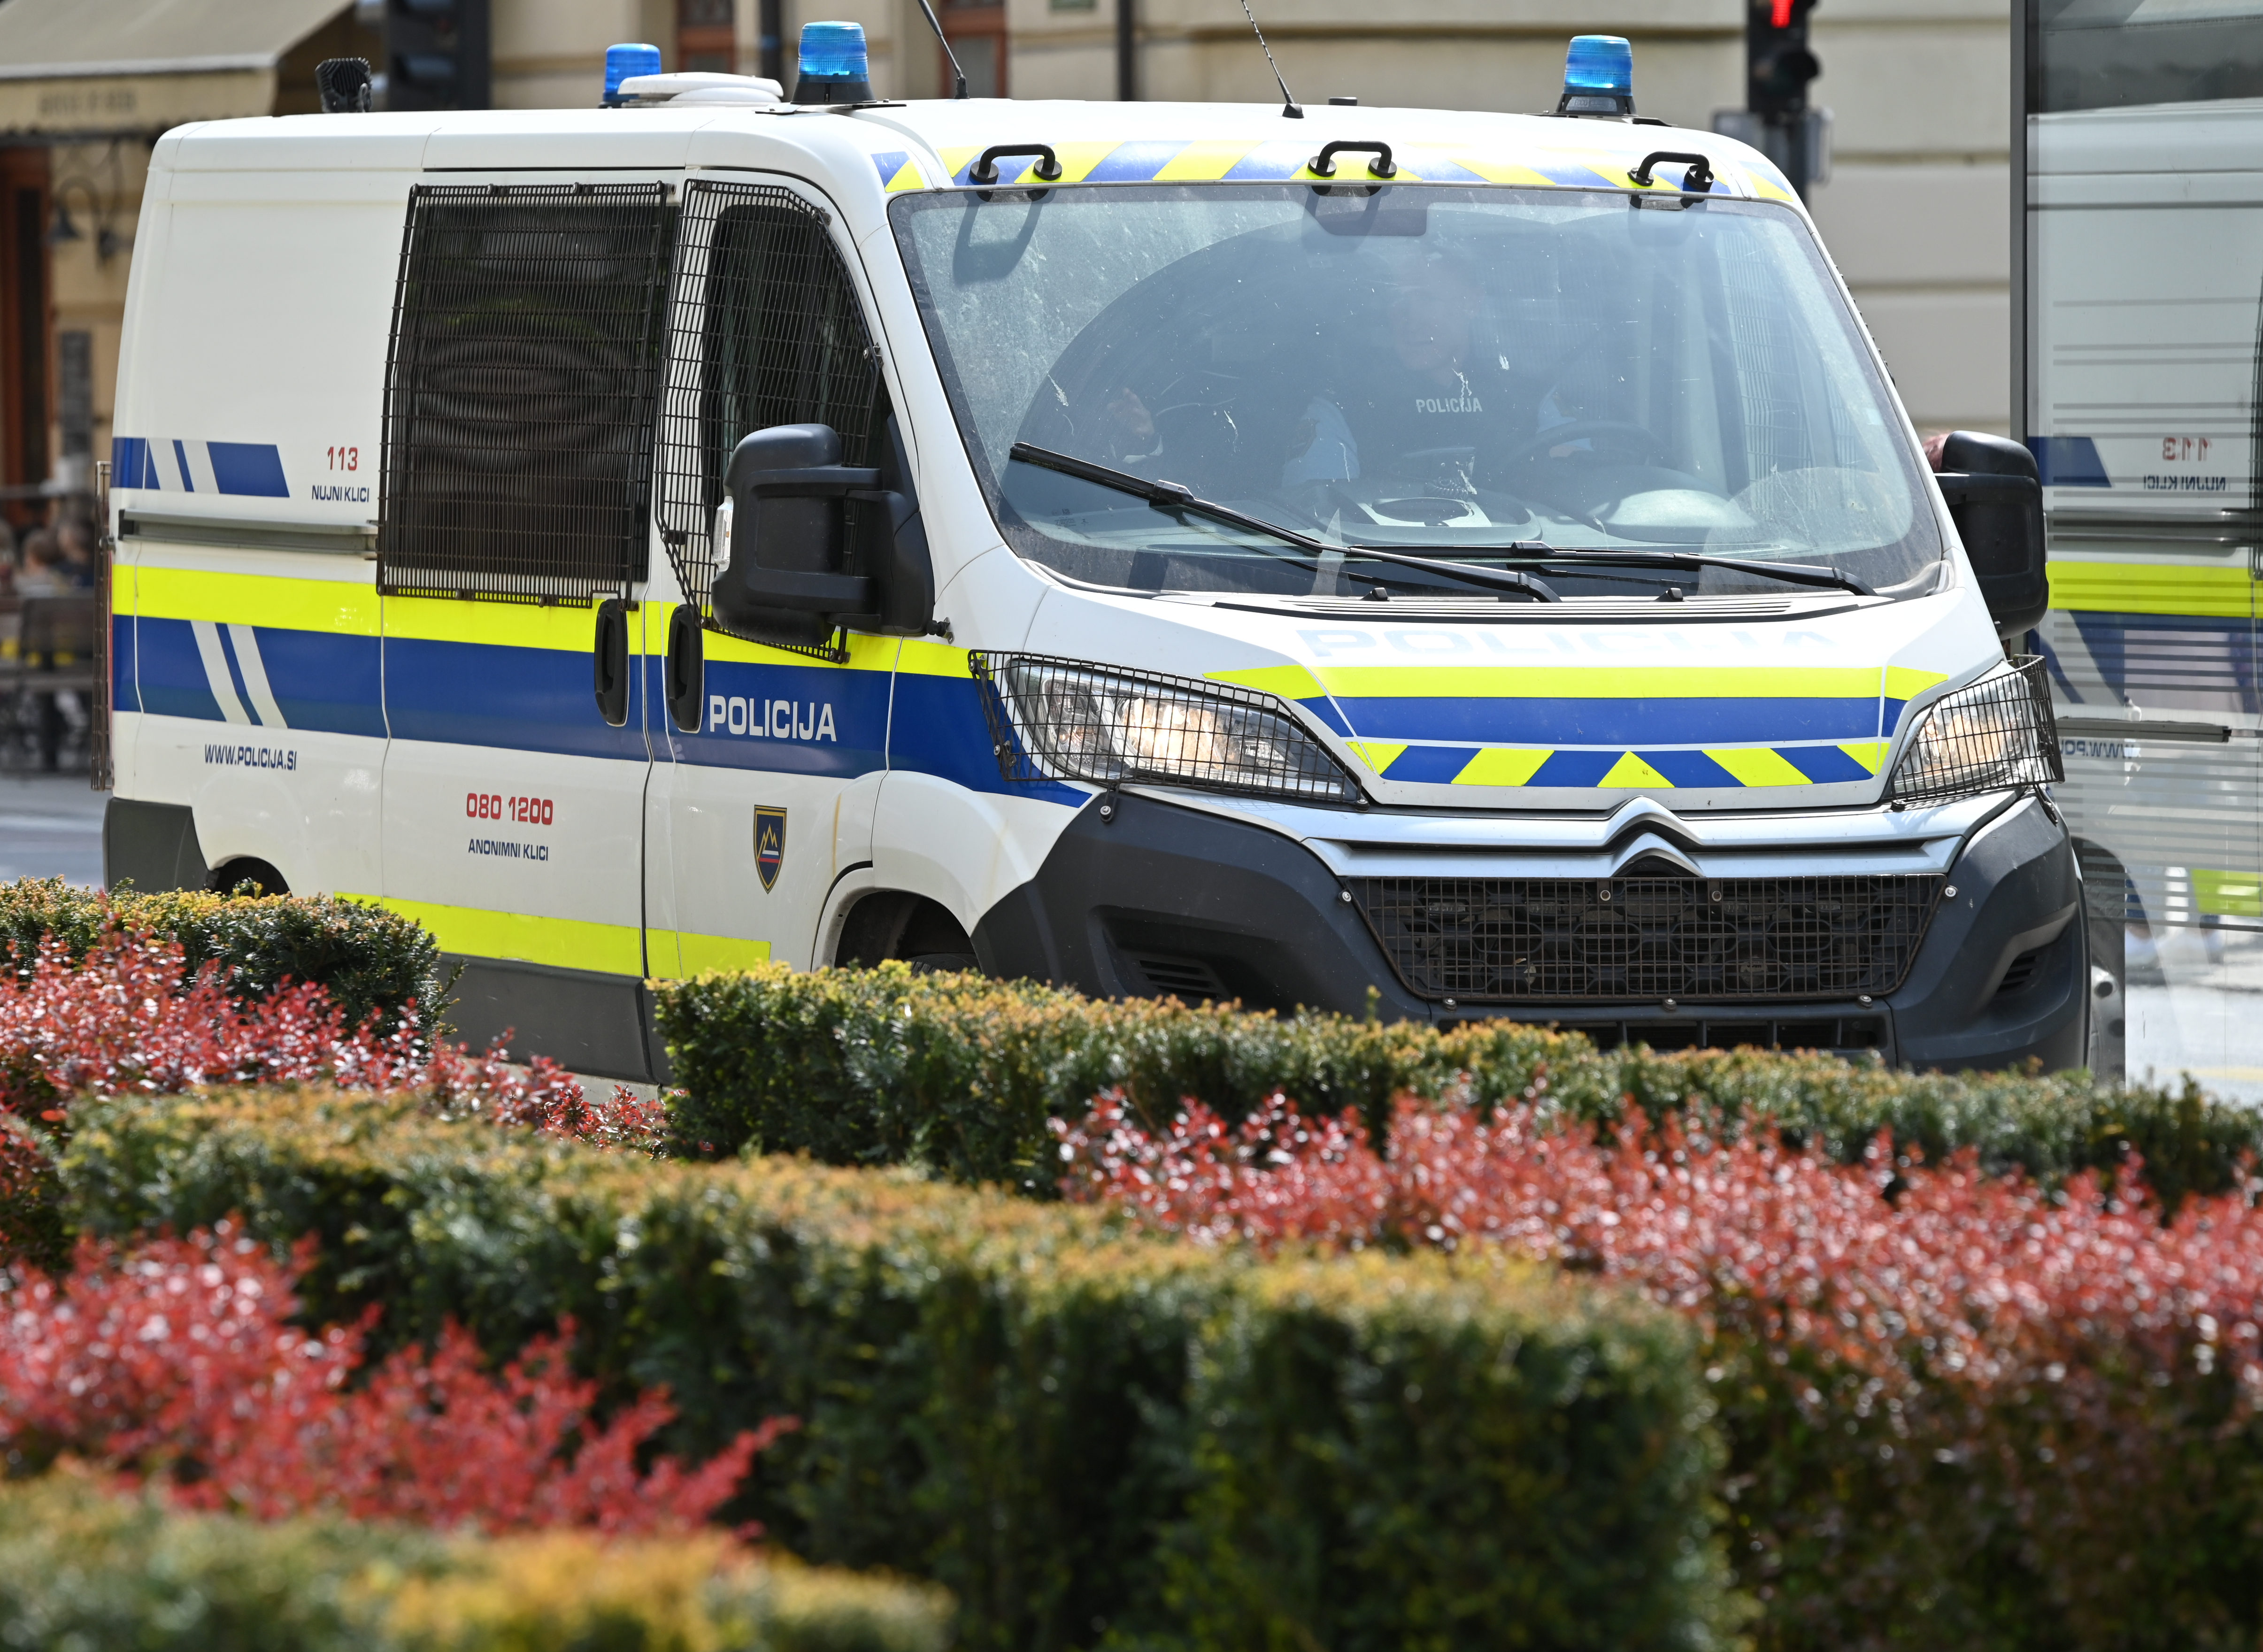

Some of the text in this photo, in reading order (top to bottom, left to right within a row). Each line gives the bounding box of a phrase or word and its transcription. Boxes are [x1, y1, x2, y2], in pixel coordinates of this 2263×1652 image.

[1416, 398, 1483, 413] POLICIJA
[327, 446, 358, 471] 113
[312, 484, 369, 502] NUJNI KLICI
[709, 695, 837, 742] POLICIJA
[204, 744, 297, 770] WWW.POLICIJA.SI
[466, 793, 553, 825] 080 1200
[468, 838, 548, 861] ANONIMNI KLICI
